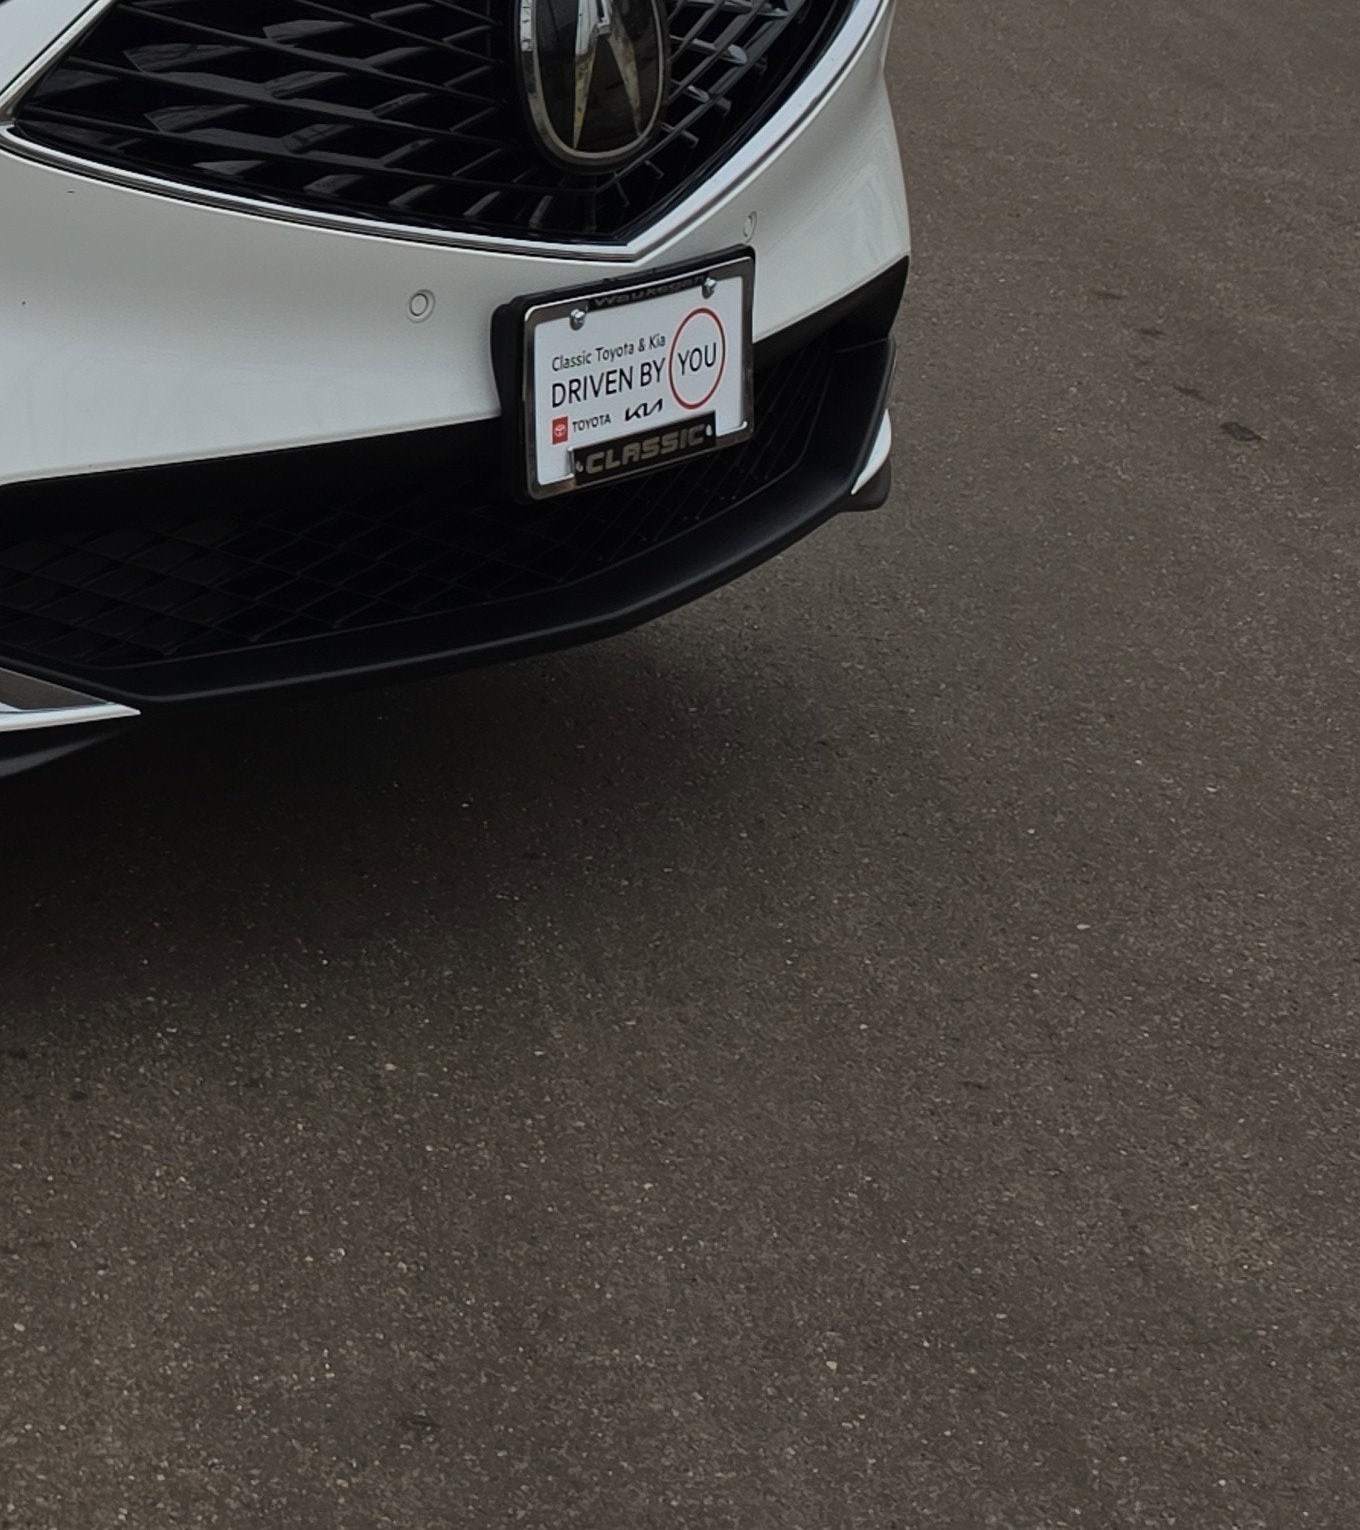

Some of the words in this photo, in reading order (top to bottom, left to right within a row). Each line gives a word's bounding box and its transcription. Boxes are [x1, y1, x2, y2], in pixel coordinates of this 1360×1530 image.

[552, 351, 592, 372] Classic
[595, 342, 635, 363] Toyota
[638, 338, 646, 352] &
[650, 333, 666, 350] Kia
[552, 366, 633, 408] DRIVEN
[640, 358, 666, 387] BY
[678, 343, 717, 376] YOU
[572, 414, 612, 432] TOYOTA
[586, 424, 705, 474] CLASSIC
